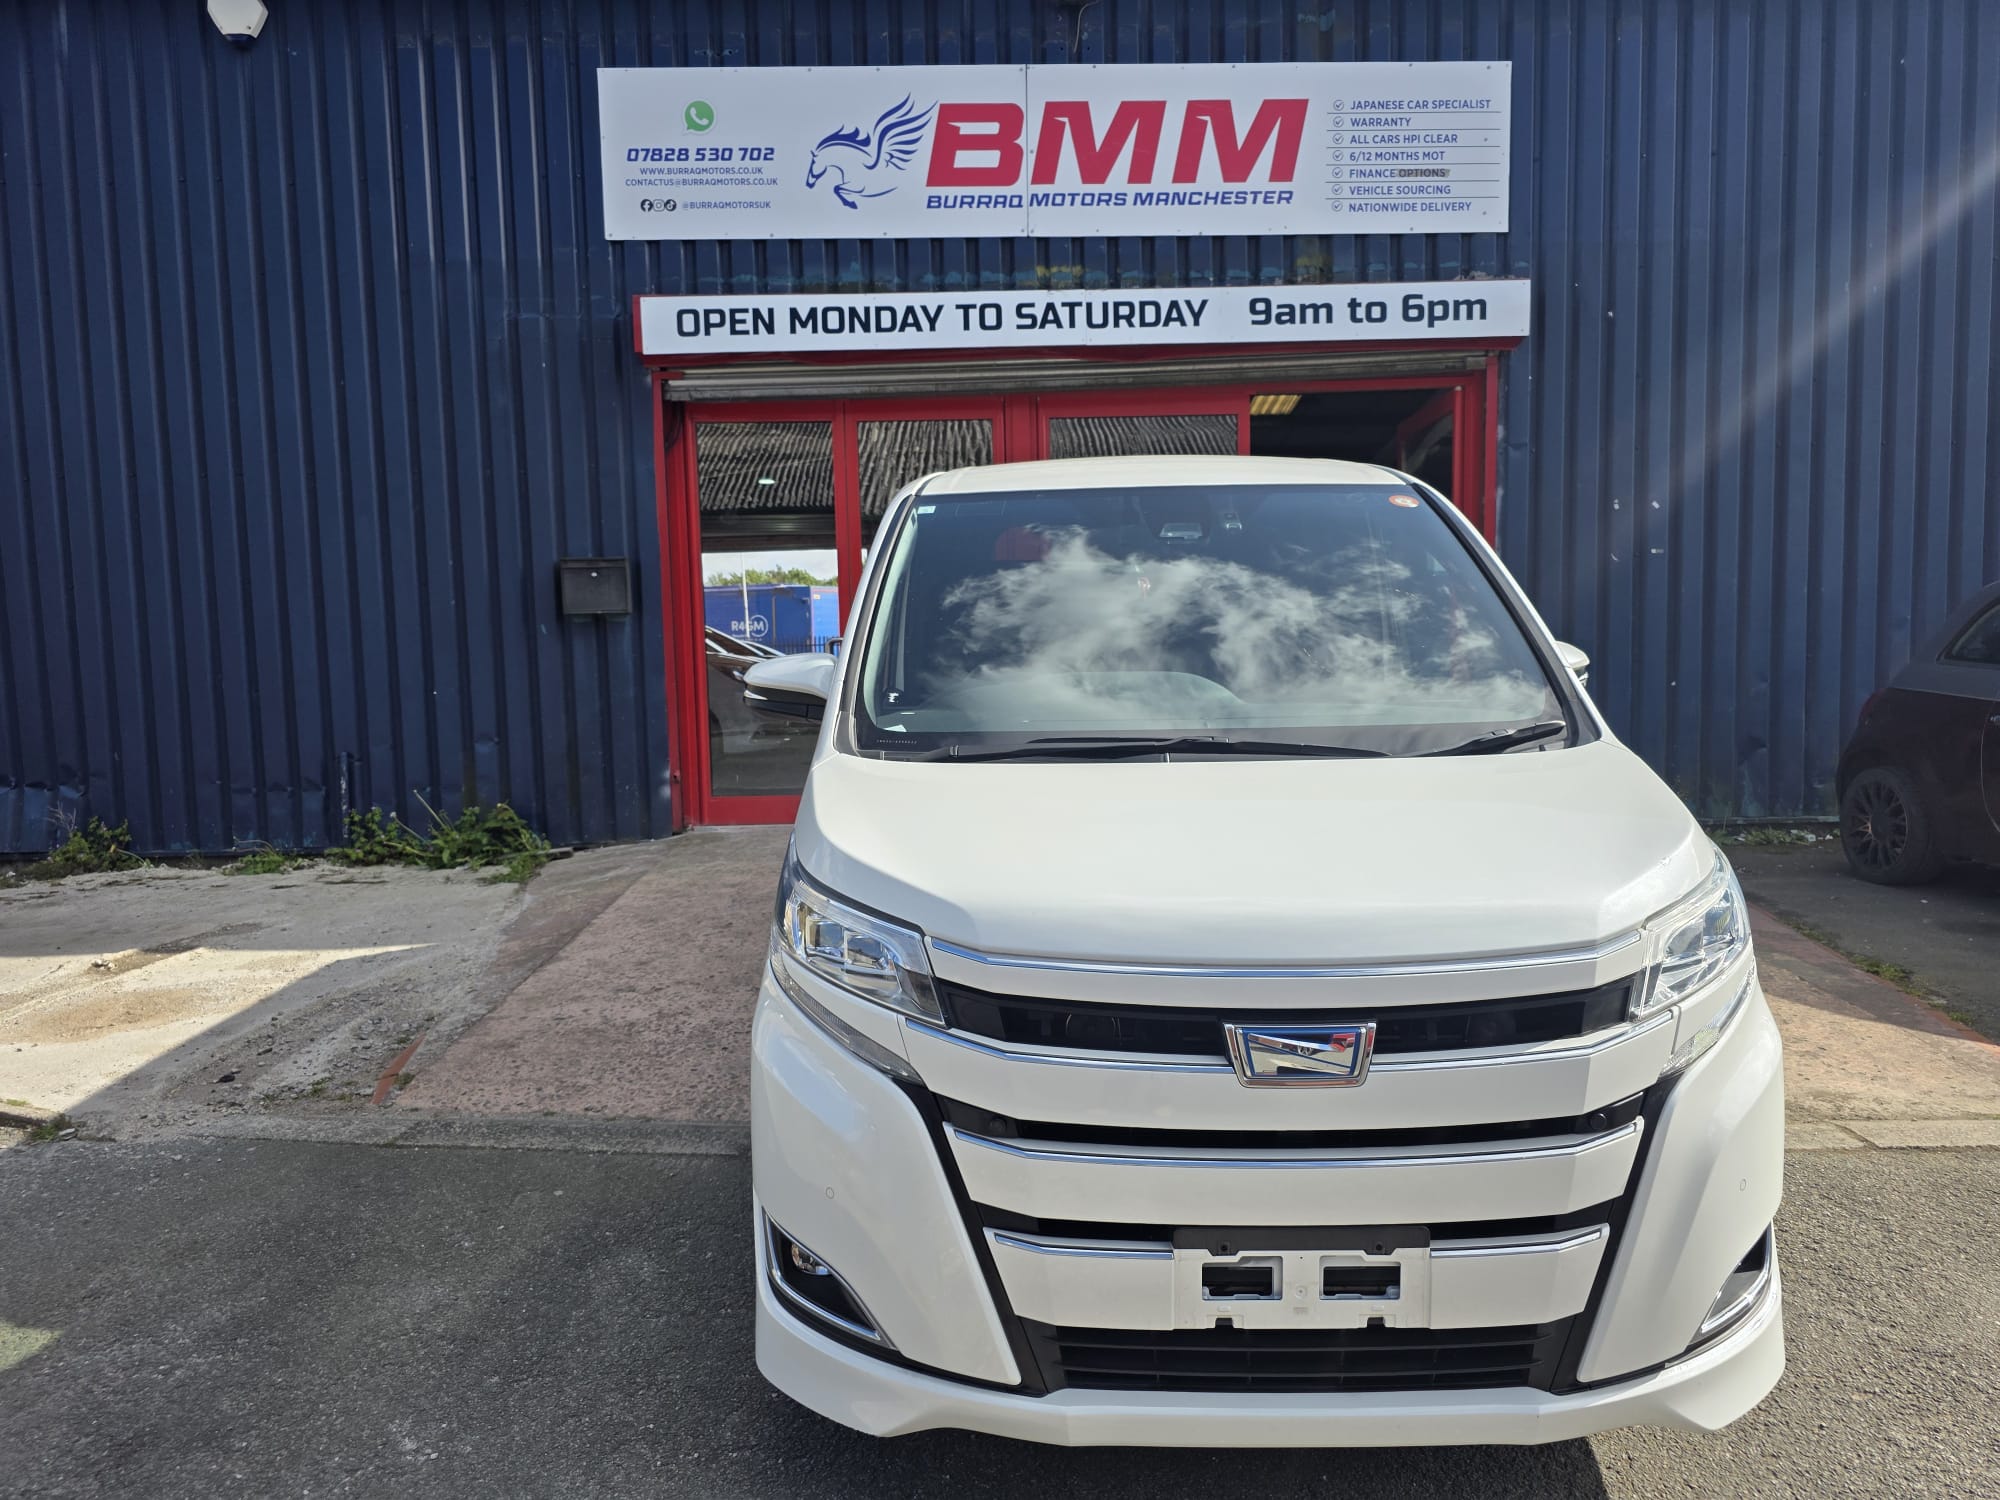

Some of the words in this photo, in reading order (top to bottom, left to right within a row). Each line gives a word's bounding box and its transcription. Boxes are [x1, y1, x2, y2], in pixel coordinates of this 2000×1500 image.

[1350, 100, 1405, 110] JAPANESE
[1407, 100, 1429, 110] CAR
[1431, 99, 1491, 109] SPECIALIST
[1350, 117, 1412, 127] WARRANTY
[926, 98, 1309, 187] BMM
[1350, 135, 1370, 144] ALL
[1372, 134, 1401, 144] CARS
[1403, 134, 1421, 144] HPI
[1423, 134, 1458, 143] CLEAR
[626, 147, 690, 162] 07828
[694, 147, 733, 162] 530
[738, 147, 775, 161] 702
[1349, 152, 1372, 163] 6/12
[1375, 151, 1420, 161] MONTHS
[1422, 151, 1446, 161] MOT
[639, 167, 763, 175] WWW.BURRAQMOTORS.CO.UK
[1349, 169, 1397, 178] FINANCE
[1398, 168, 1446, 178] OPTIONS
[625, 177, 778, 187] CONTACTUS@BURRAQMOTORS.CO.UK
[1349, 186, 1393, 195] VEHICLE
[1396, 185, 1451, 195] SOURCING
[926, 194, 1024, 209] BURRAQ
[1029, 192, 1128, 208] MOTORS
[1133, 190, 1294, 207] MANCHESTER
[682, 201, 771, 209] @BURRAQMOTORSUK
[1349, 202, 1418, 212] NATIONWIDE
[1420, 202, 1472, 212] DELIVERY
[676, 307, 776, 337] OPEN
[789, 304, 944, 335] MONDAY
[955, 302, 1002, 331] TO
[1015, 299, 1209, 330] SATURDAY
[1248, 297, 1334, 325] 9am
[1347, 297, 1388, 323] to
[1401, 294, 1488, 328] 6pm
